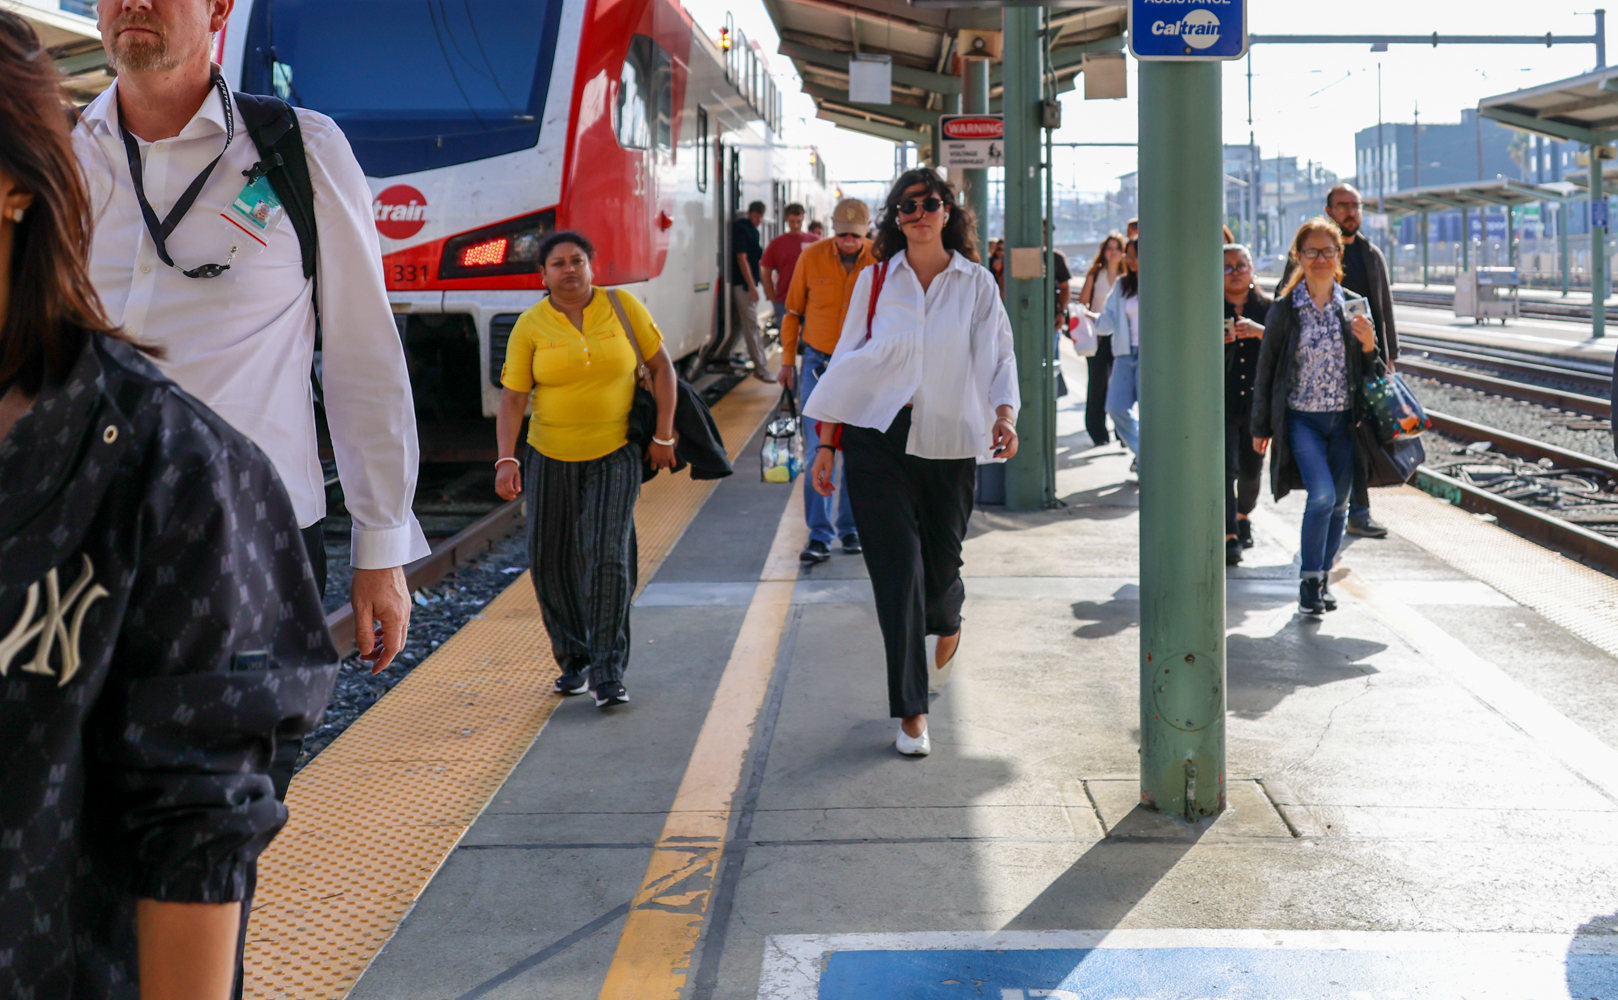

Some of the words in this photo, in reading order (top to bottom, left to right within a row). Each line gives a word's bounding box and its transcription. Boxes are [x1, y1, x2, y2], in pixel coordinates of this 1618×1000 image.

[1151, 20, 1221, 36] Caltrain
[947, 123, 1003, 133] WARNING
[393, 264, 429, 282] 331
[0, 552, 111, 688] NY
